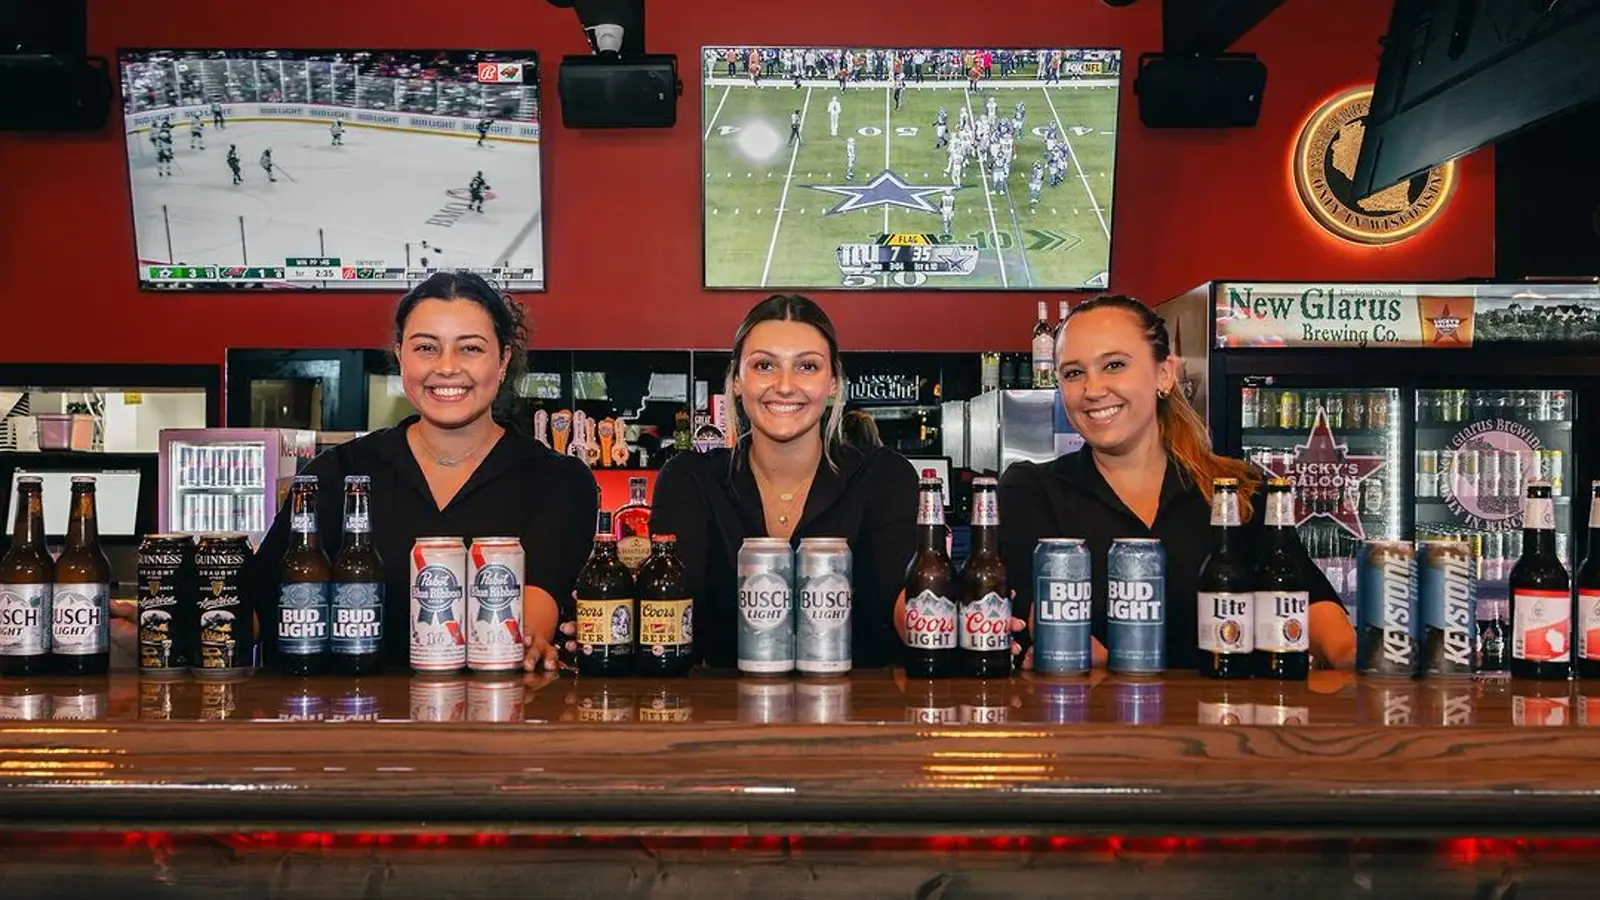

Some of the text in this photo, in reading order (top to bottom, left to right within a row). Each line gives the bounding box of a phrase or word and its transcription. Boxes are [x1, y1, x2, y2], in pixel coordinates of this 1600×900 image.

[1369, 177, 1443, 230] WISCONSIN
[898, 235, 919, 244] FLAG
[891, 246, 901, 262] 7
[912, 246, 931, 262] 35
[188, 268, 197, 279] 3
[257, 269, 265, 279] 1
[315, 270, 334, 278] 2:35
[1228, 287, 1402, 321] New Glarus
[1302, 323, 1400, 348] Brewing Co.
[1284, 463, 1359, 475] LUCKY'S
[1287, 475, 1358, 488] SALOON
[195, 554, 245, 565] GUINNESS
[420, 570, 449, 587] Pabst
[480, 570, 509, 586] Pabst
[429, 586, 463, 600] Ribbon
[489, 585, 520, 599] Ribbon
[1050, 581, 1092, 601] BUD
[1108, 581, 1154, 601] BUD
[739, 591, 793, 609] BUSCH
[801, 591, 852, 609] BUSCH
[1213, 598, 1247, 618] Lite
[1275, 597, 1306, 617] Lite
[1384, 549, 1411, 665] KEYSTONE
[1444, 550, 1471, 666] KEYSTONE
[282, 609, 320, 623] BUD
[337, 609, 376, 623] BUD
[642, 603, 675, 618] Coors
[747, 610, 782, 619] LIGHT
[812, 610, 847, 619] LIGHT
[1041, 600, 1092, 620] LIGH
[1107, 600, 1161, 620] IGHT
[905, 609, 955, 633] Coors
[278, 621, 327, 638] LIGHT
[332, 621, 381, 638] LIGHT
[642, 634, 675, 643] BEER
[907, 632, 951, 646] LIGHT
